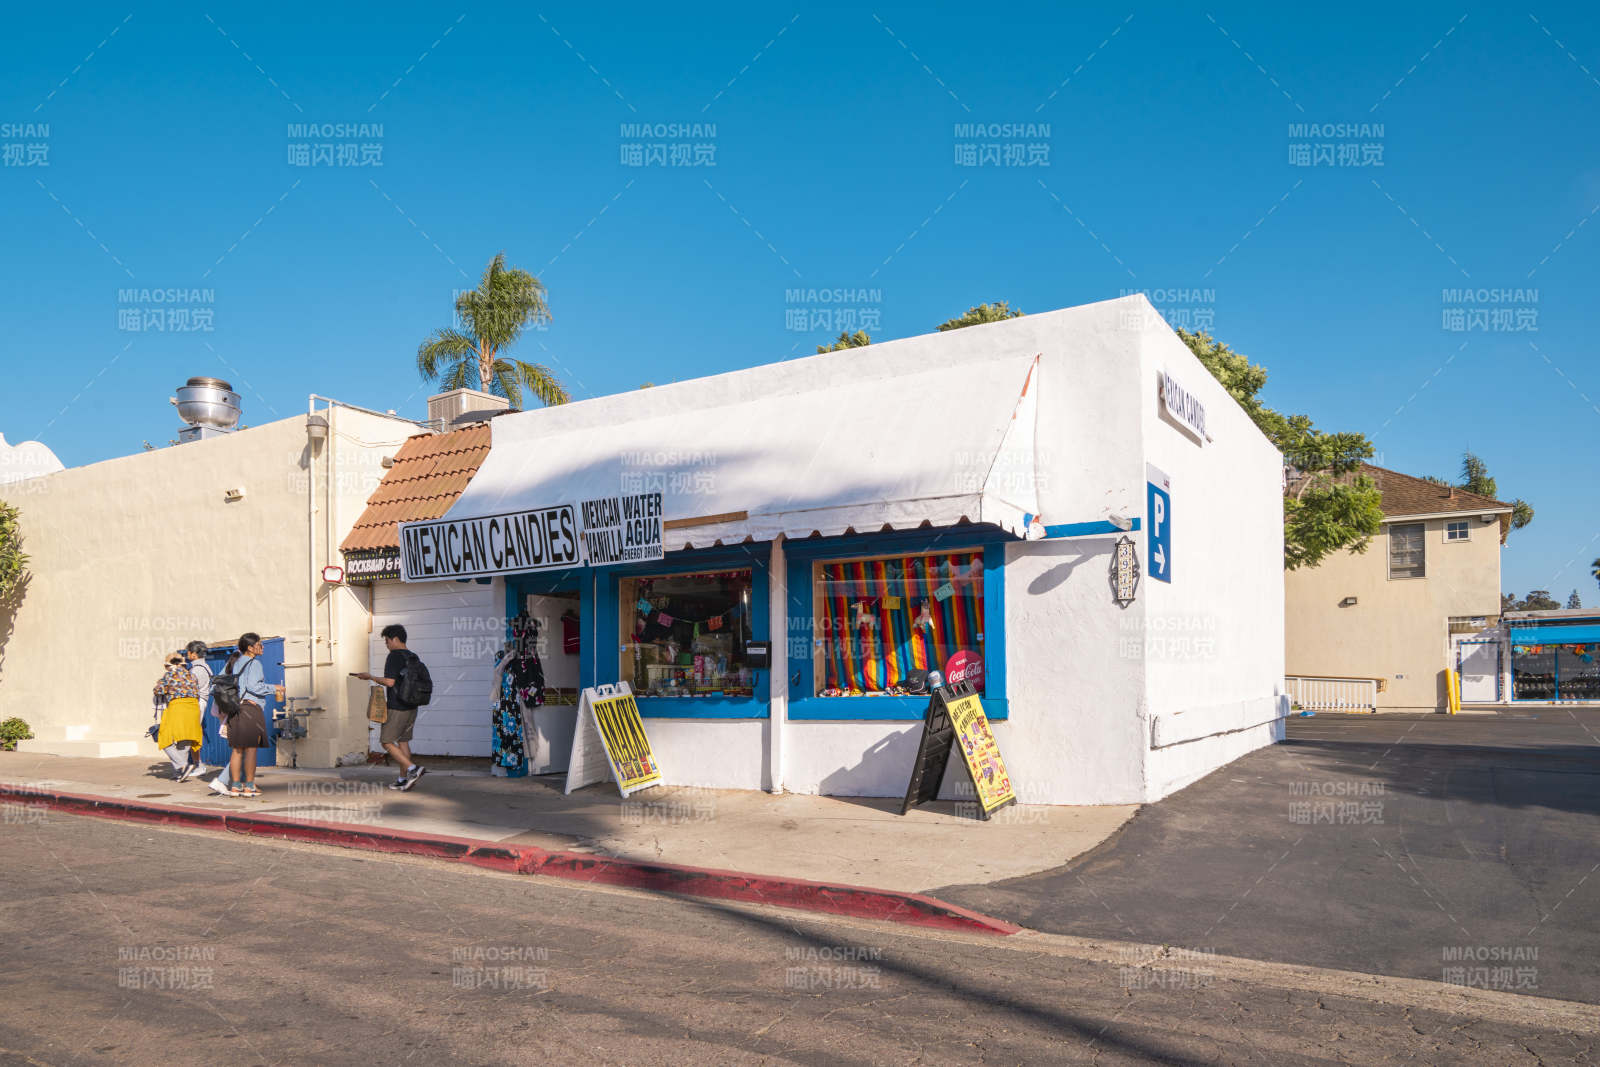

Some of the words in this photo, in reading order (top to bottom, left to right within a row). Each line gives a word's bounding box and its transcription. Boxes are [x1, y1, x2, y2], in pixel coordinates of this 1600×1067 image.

[581, 497, 620, 529] MEXICAN
[622, 493, 662, 520] WATER
[1154, 492, 1165, 538] P
[405, 521, 489, 576] MEXICAN
[489, 508, 575, 566] CANDIES
[585, 530, 625, 564] VANILLA
[625, 517, 661, 546] AGUA
[386, 557, 394, 571] &
[624, 547, 643, 560] ENERGY
[644, 545, 662, 559] DRINKS
